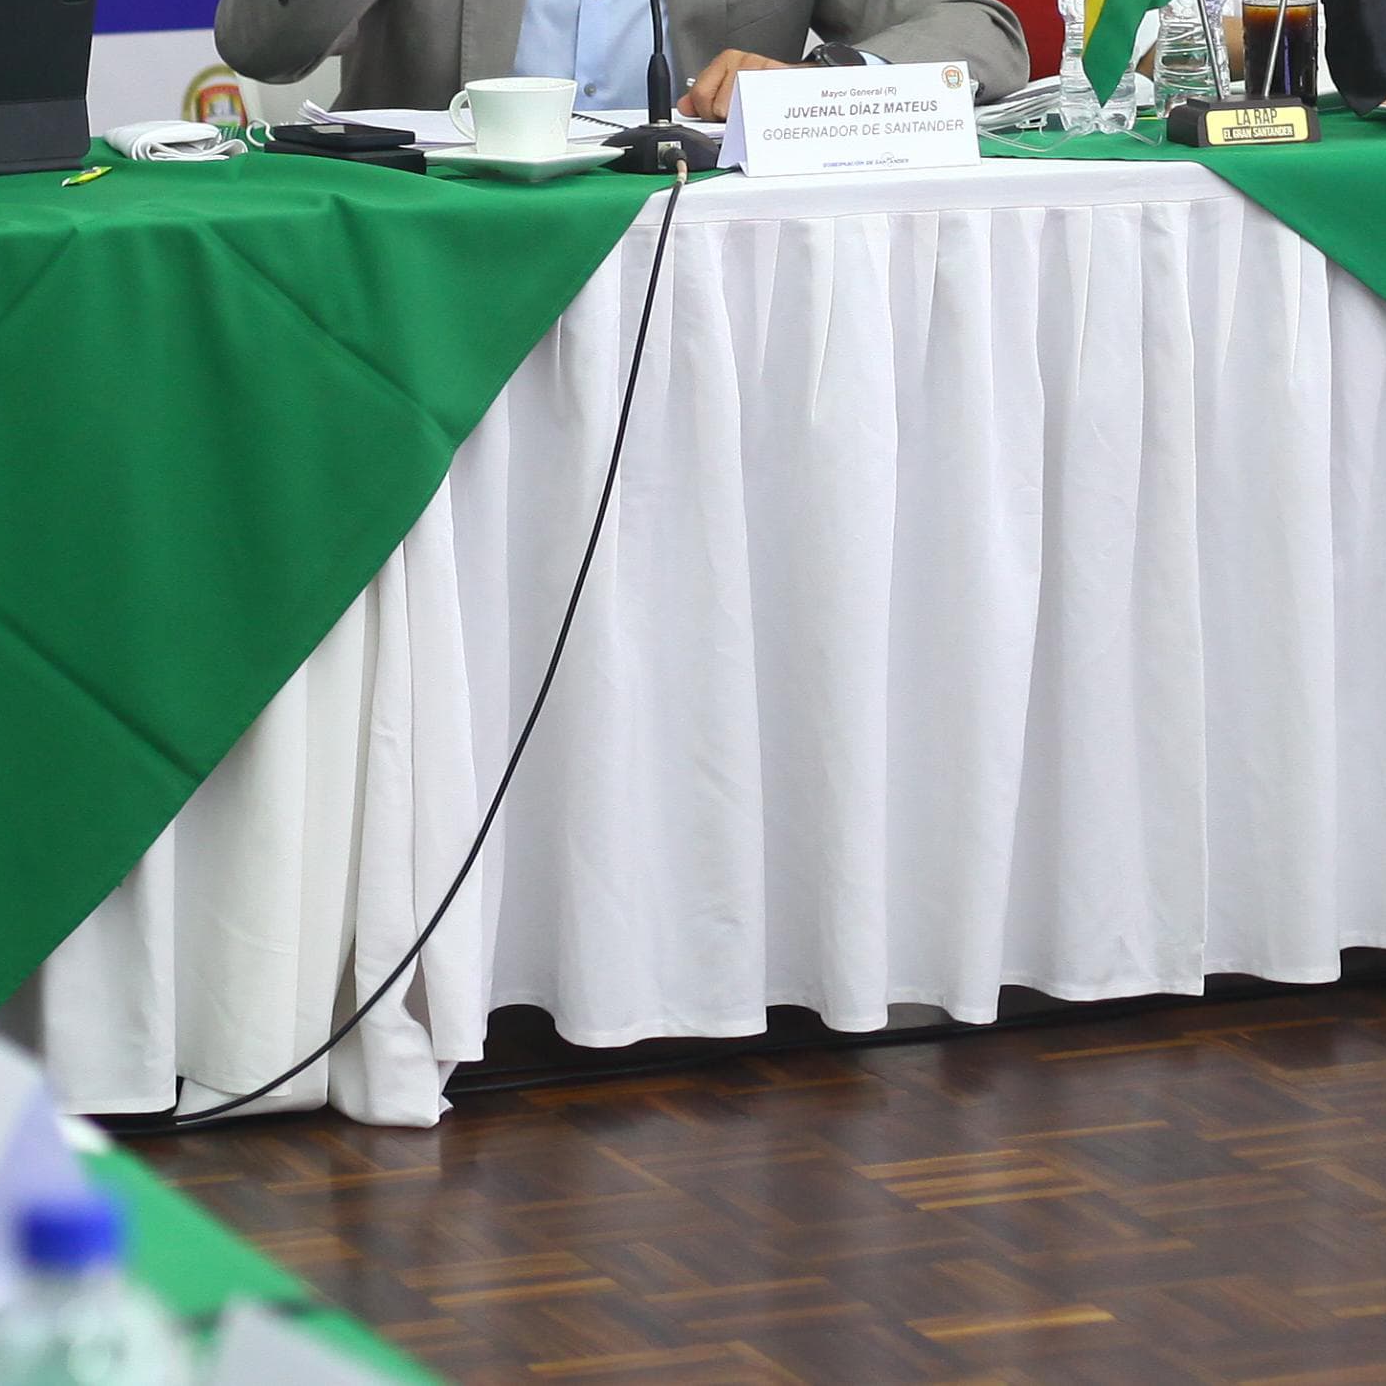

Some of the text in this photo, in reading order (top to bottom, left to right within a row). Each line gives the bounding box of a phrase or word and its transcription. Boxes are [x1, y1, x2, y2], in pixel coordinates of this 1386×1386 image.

[821, 86, 897, 99] Mayor General (R)
[784, 99, 938, 119] JUVENAL DÍAZ MATEUS
[1236, 108, 1278, 125] LA RAP
[763, 119, 964, 141] GOBERNADOR DE SANTANDER
[1224, 125, 1293, 140] EL GRAN SANTANDER
